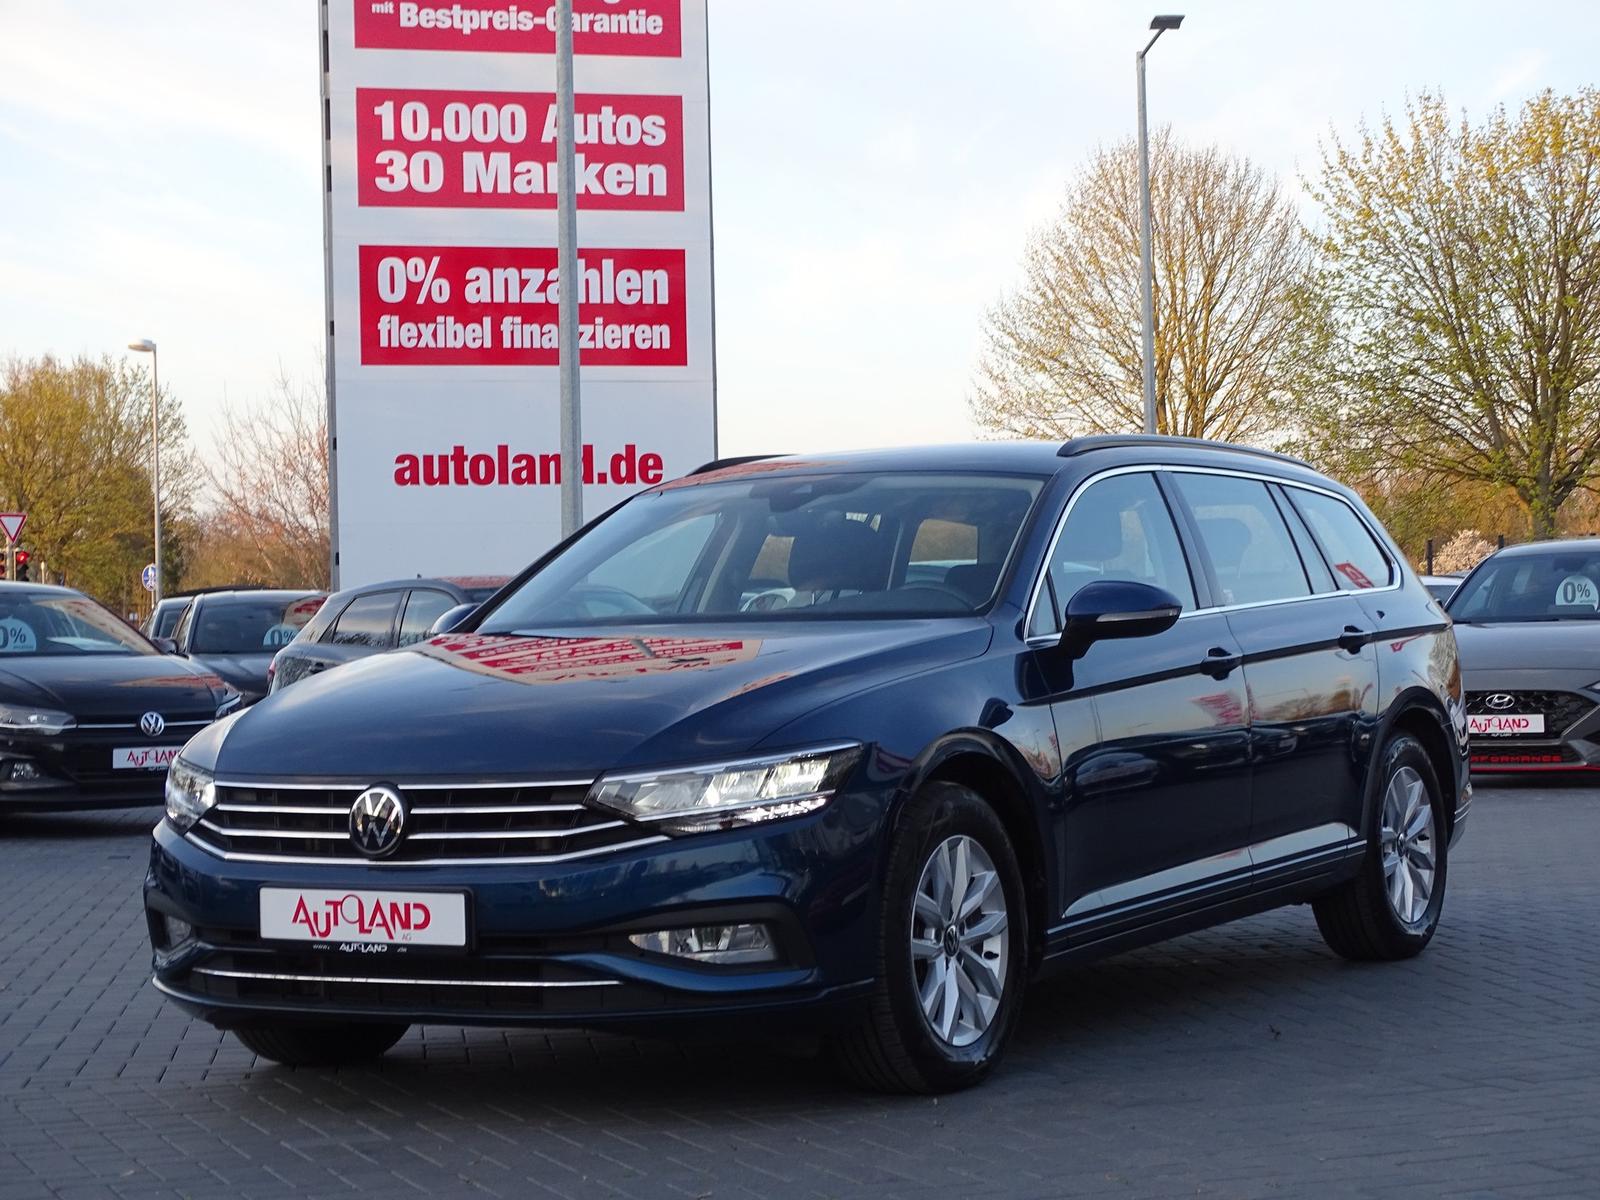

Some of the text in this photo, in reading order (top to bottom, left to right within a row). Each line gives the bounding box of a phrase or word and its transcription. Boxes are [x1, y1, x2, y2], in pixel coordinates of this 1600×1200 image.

[371, 1, 394, 14] mit
[373, 100, 527, 143] 10.000
[374, 150, 444, 193] 30
[377, 255, 451, 304] 0%
[377, 314, 671, 350] flexibel finazieren
[1563, 582, 1590, 603] 0%
[127, 748, 178, 767] AUTOLAN
[292, 893, 431, 940] AUTOLAND
